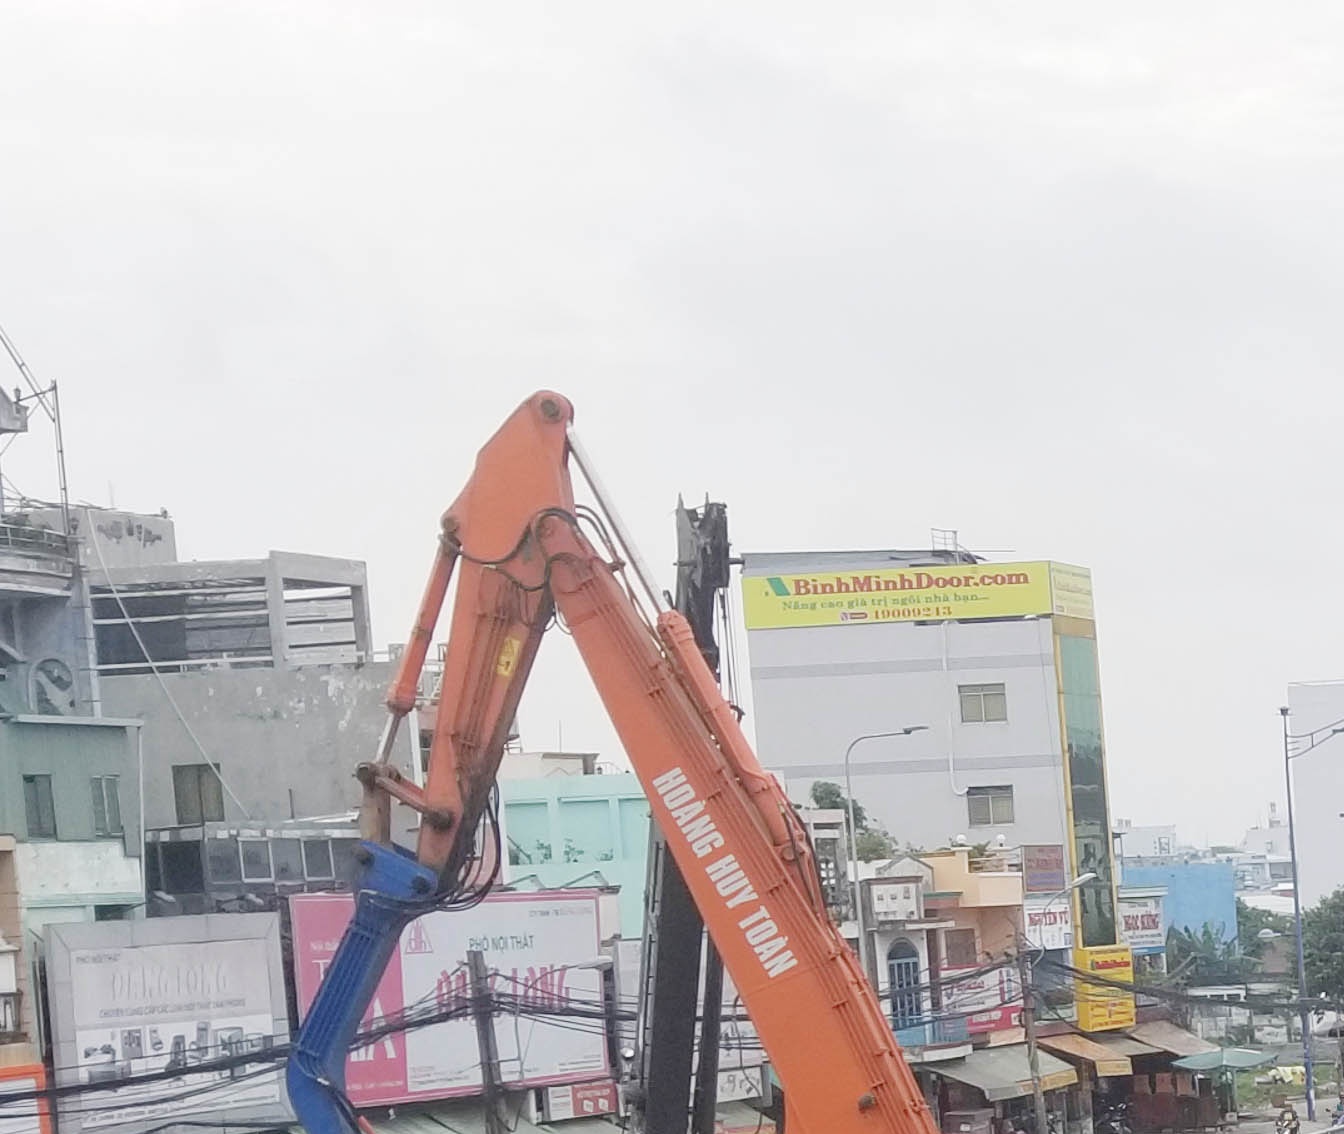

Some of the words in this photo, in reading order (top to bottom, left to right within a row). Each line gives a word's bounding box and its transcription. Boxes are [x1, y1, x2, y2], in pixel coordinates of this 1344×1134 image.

[793, 572, 1029, 596] BinhMinhDoor.com
[652, 767, 725, 858] HOÀNG
[705, 854, 759, 909] HUY
[738, 905, 798, 978] TOÀN
